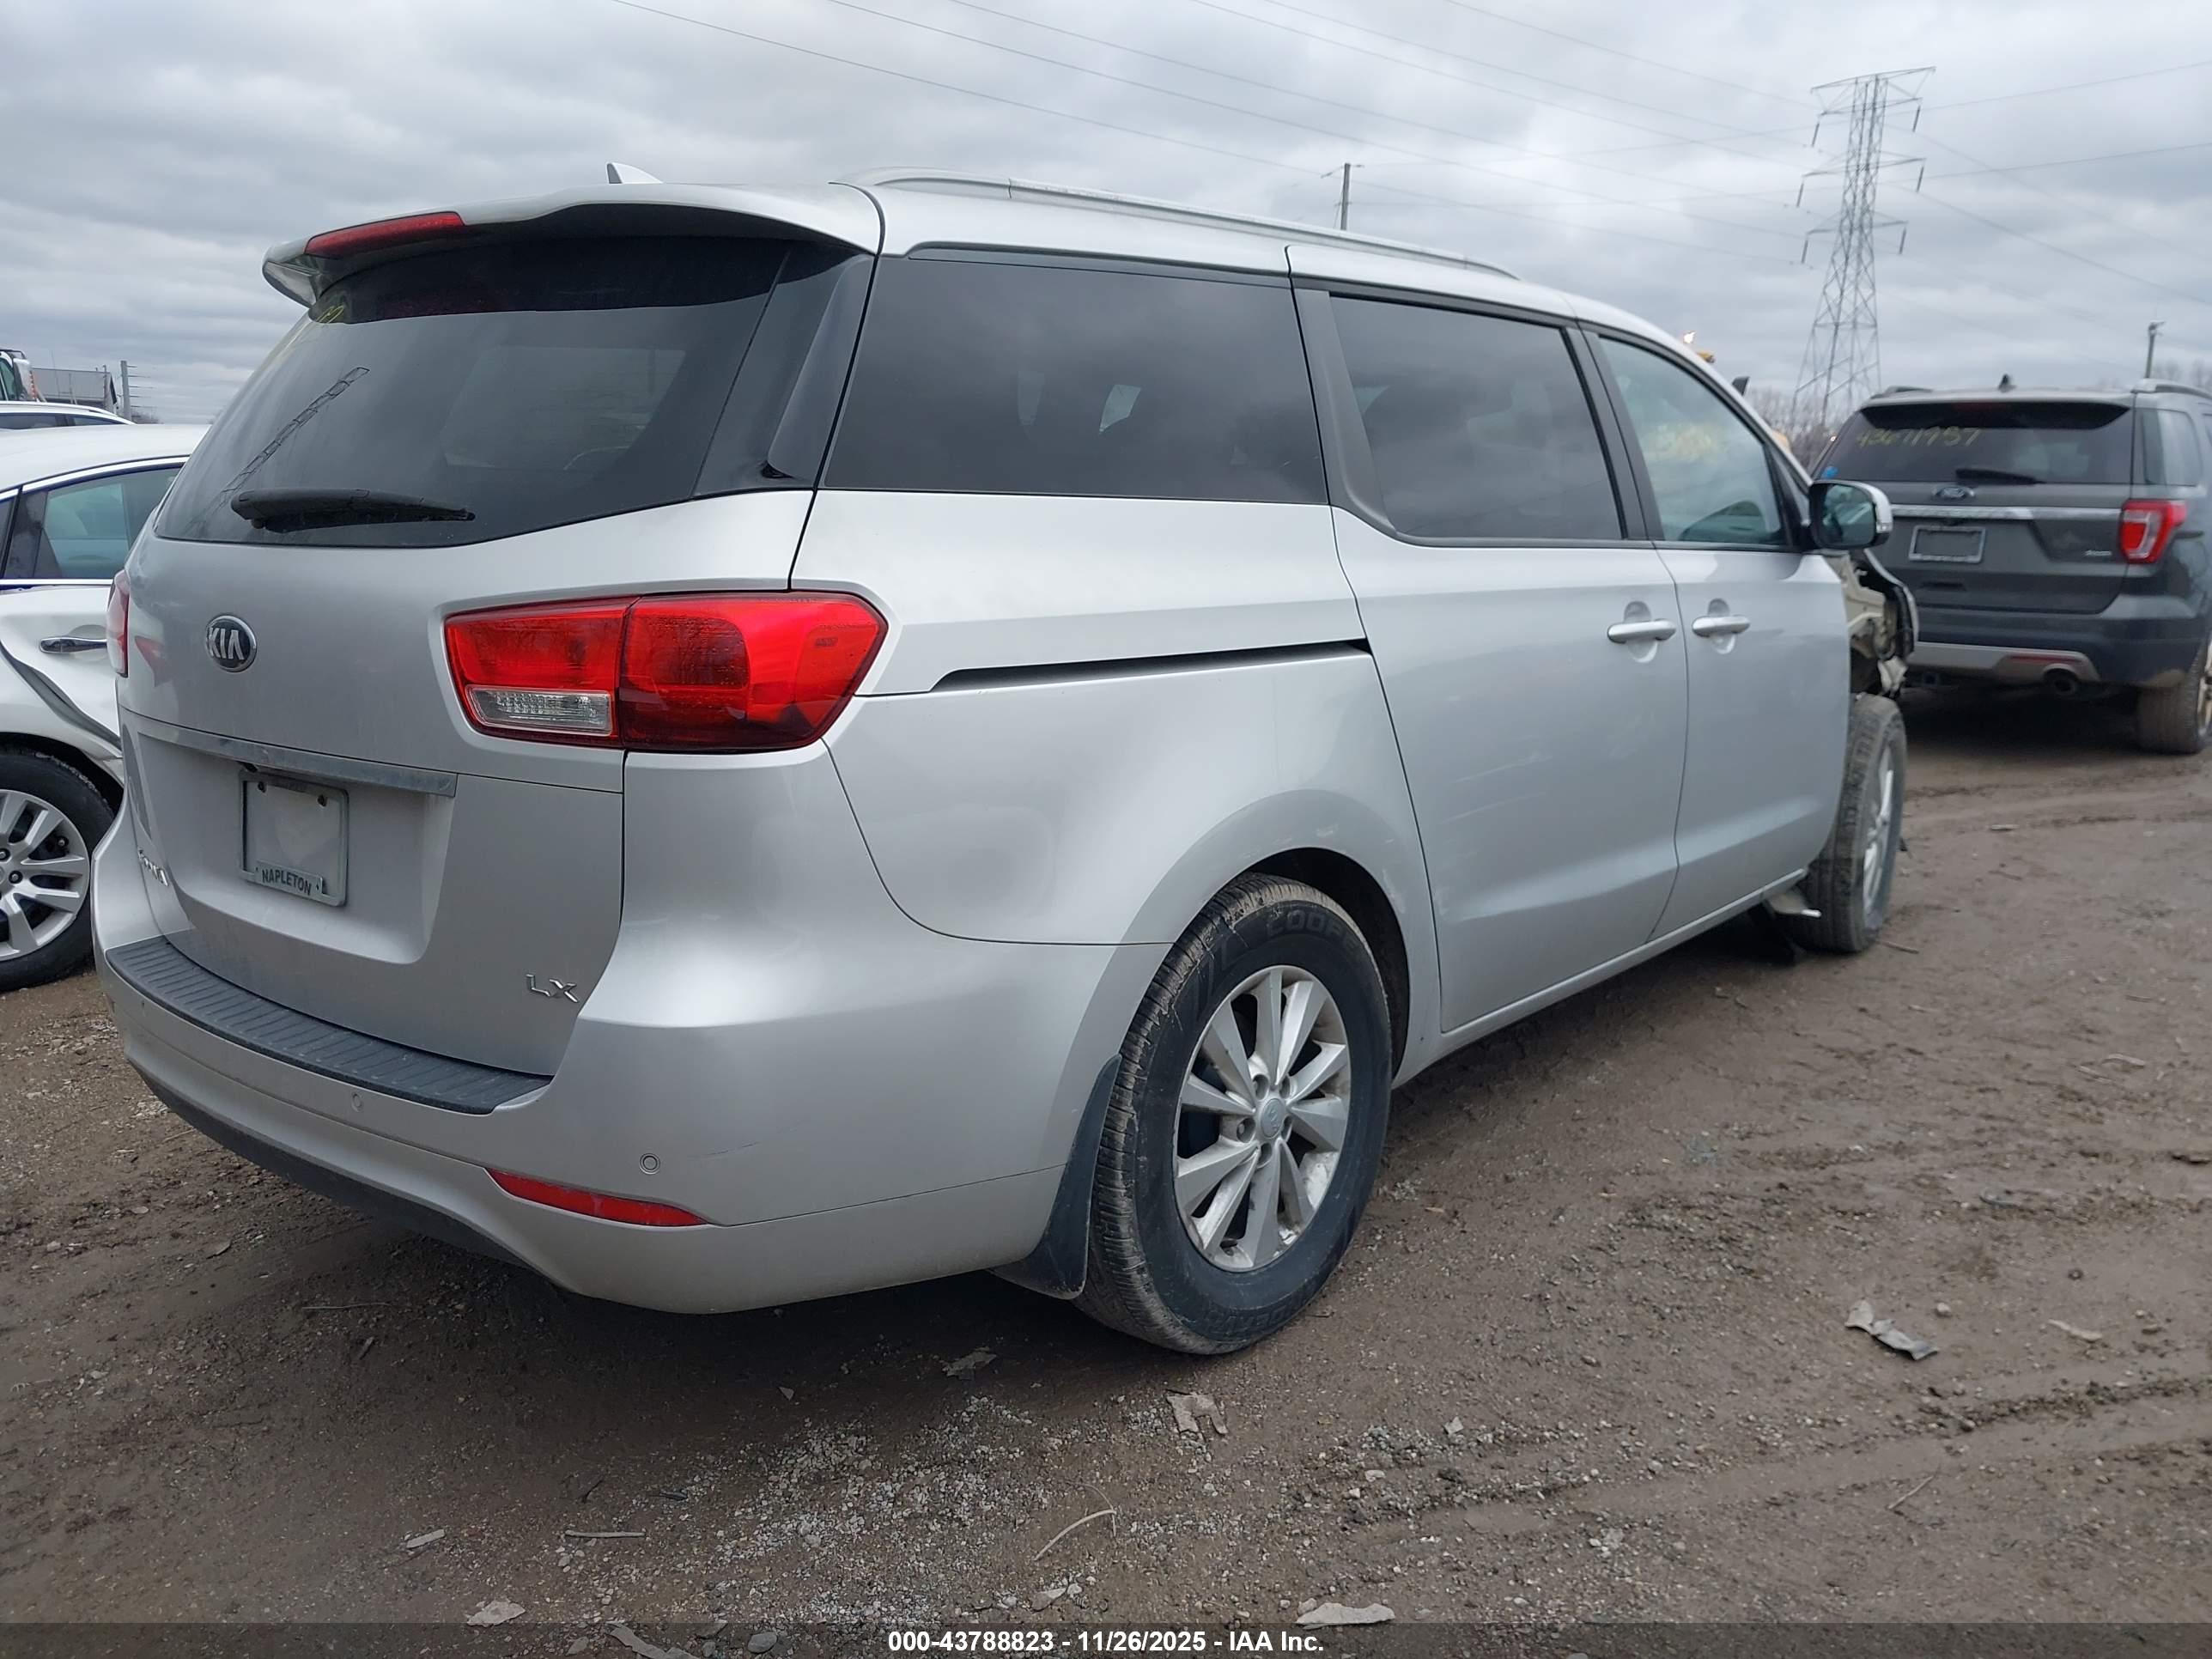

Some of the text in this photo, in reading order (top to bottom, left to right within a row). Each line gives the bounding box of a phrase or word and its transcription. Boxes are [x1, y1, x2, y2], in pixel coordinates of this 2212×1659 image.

[208, 627, 245, 660] KIA
[262, 869, 312, 896] NAPLETON
[526, 973, 578, 1003] LX
